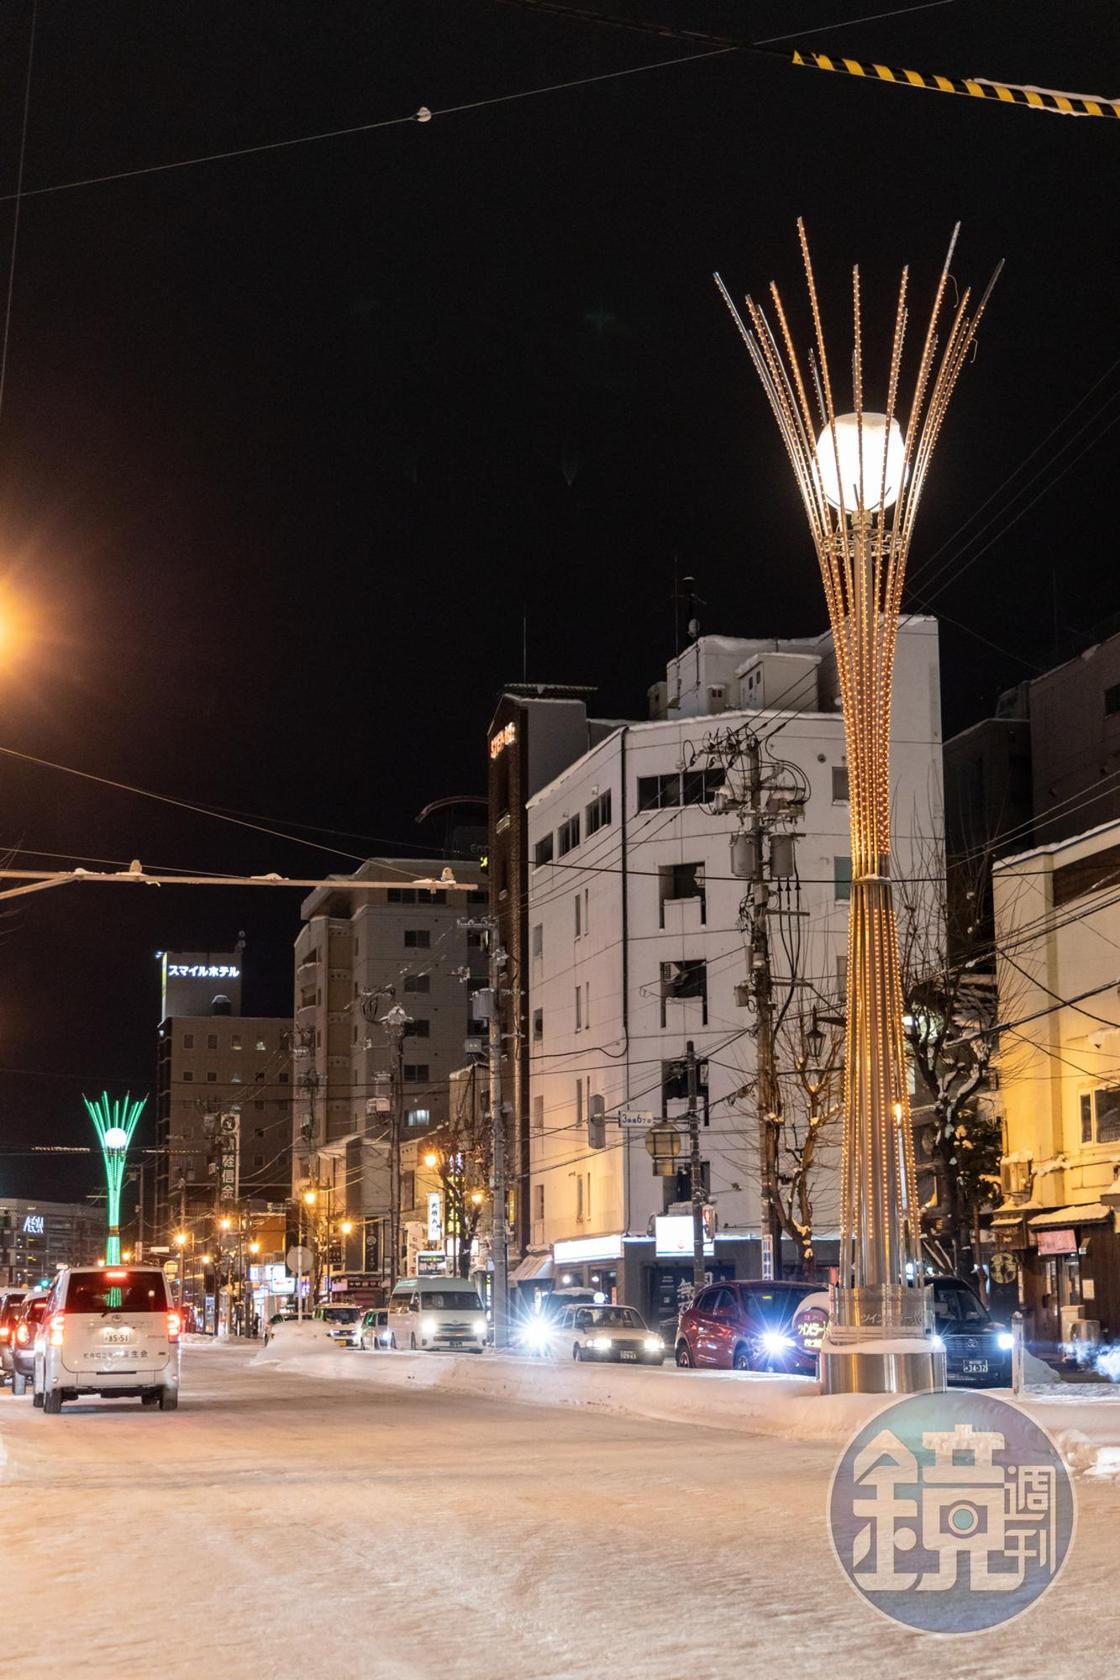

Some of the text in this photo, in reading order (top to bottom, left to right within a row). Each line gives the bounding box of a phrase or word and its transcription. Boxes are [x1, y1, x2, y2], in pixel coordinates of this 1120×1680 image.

[168, 965, 240, 978] スマイルホテル
